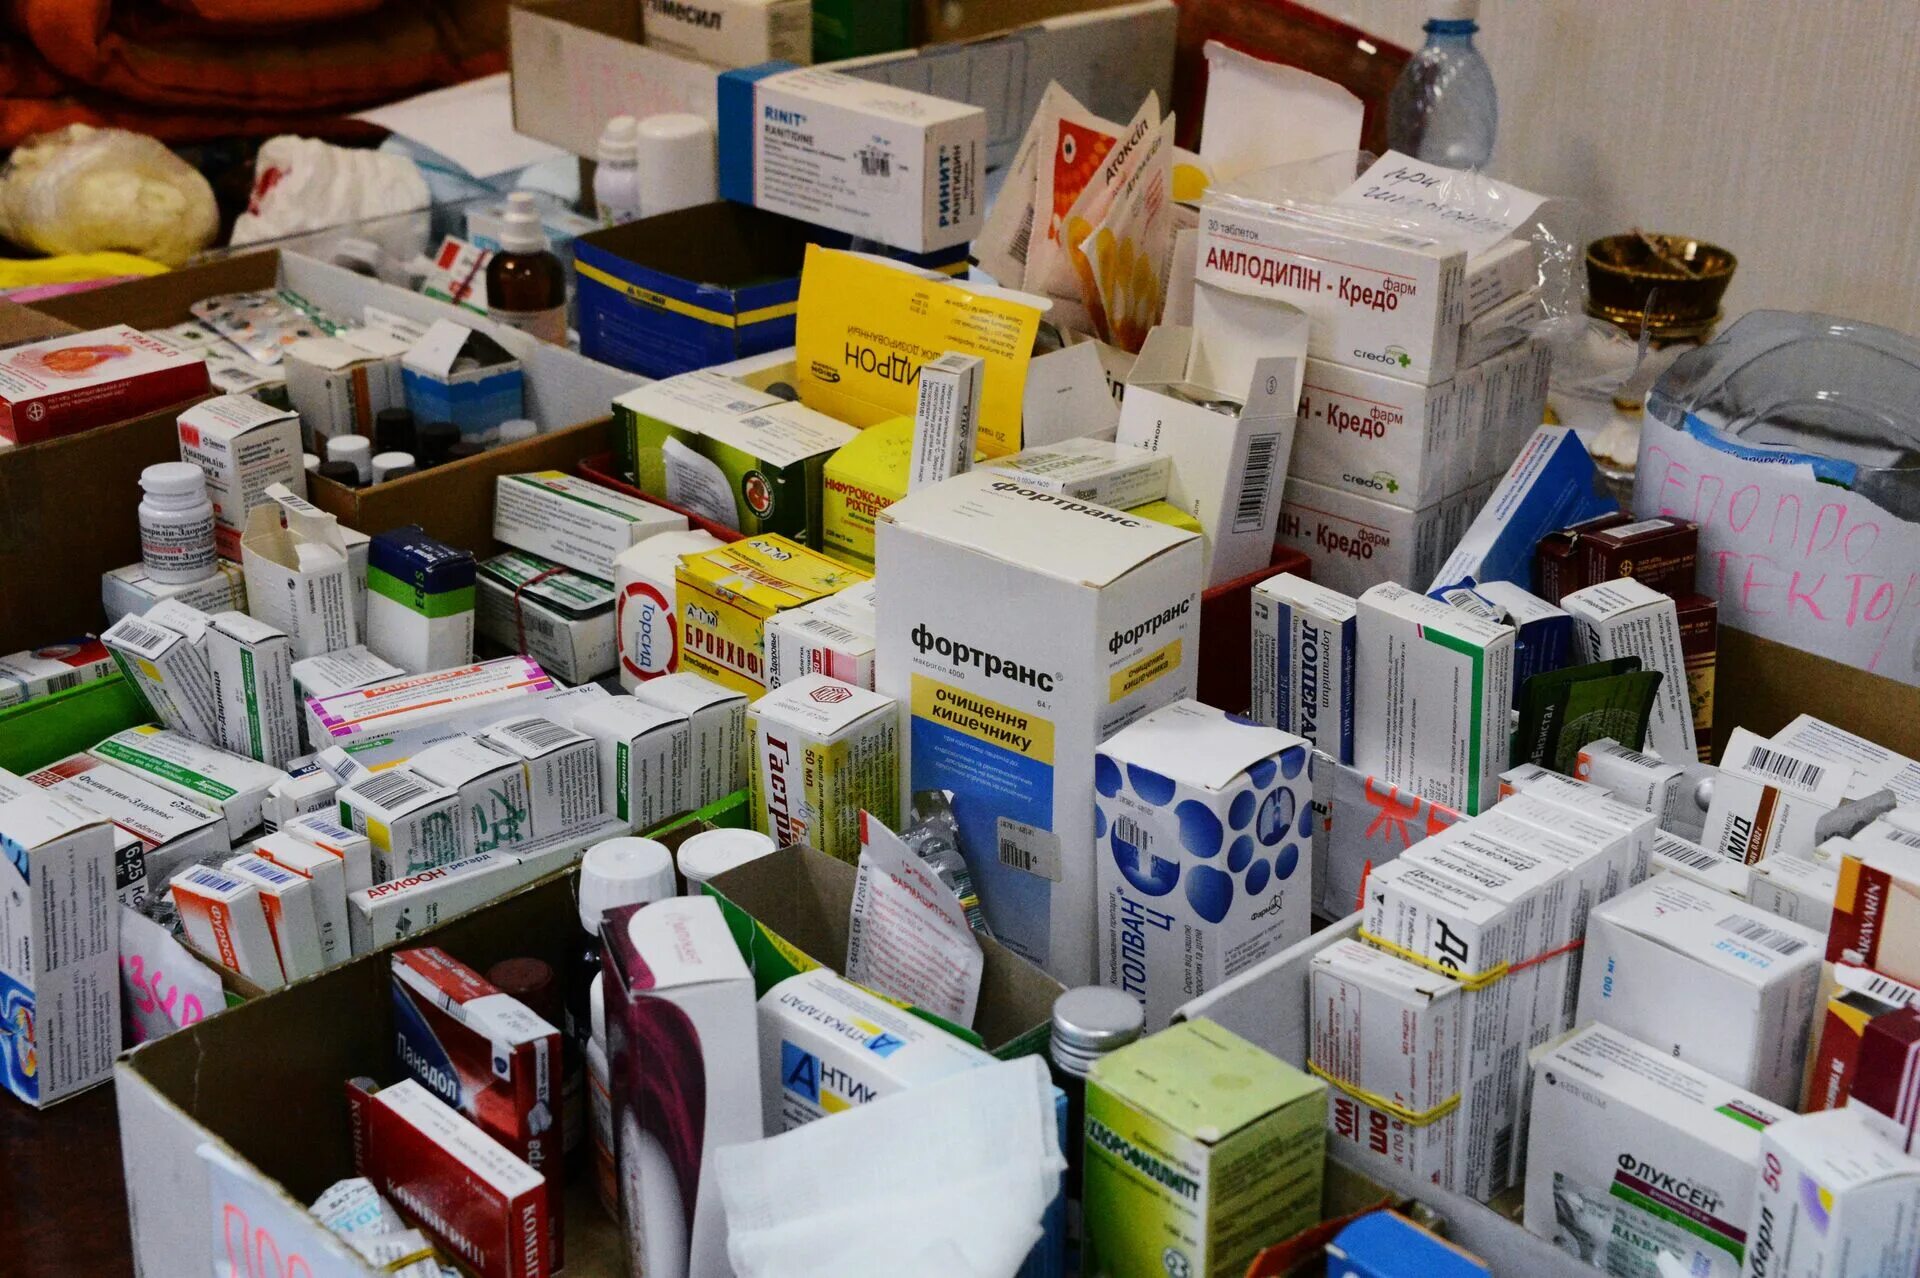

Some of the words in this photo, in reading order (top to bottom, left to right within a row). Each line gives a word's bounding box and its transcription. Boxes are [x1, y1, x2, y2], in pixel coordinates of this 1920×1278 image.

[1208, 218, 1218, 231] 30
[1220, 221, 1259, 241] таблеток
[1205, 246, 1321, 294] АМЛОДИПІН
[1339, 275, 1398, 312] Кредо
[1383, 277, 1417, 296] фарм
[845, 342, 921, 386] ИДРОН
[1353, 347, 1395, 367] credo
[1327, 402, 1385, 440] Кредо
[1370, 405, 1403, 425] фарм
[825, 477, 895, 509] НІФУРОКСАЗИ
[1342, 471, 1383, 491] credo
[991, 480, 1141, 528] фортранс
[1316, 523, 1373, 560] Кредо
[1358, 527, 1390, 548] фарм
[415, 570, 425, 610] EGIS
[640, 604, 655, 668] Торсид
[685, 623, 764, 680] БРОНХОФІ
[769, 632, 780, 673] Здоровье
[1321, 630, 1331, 708] Loperamidum
[932, 703, 1033, 752] кишечнику
[935, 688, 1029, 731] очищення
[805, 749, 814, 765] 50
[805, 768, 814, 787] мл
[766, 732, 791, 848] Гастри
[1717, 811, 1734, 855] OPERAMIDE
[1751, 831, 1762, 850] 0.002
[125, 845, 144, 881] 6,25
[366, 866, 447, 900] АРИФОН
[449, 853, 493, 873] ретард
[210, 904, 235, 968] ФУРОСЕ
[1147, 905, 1176, 932] Ц
[1606, 957, 1616, 974] мг
[1602, 977, 1614, 1000] 100
[397, 1032, 458, 1101] Панадол
[1762, 1151, 1782, 1193] 50
